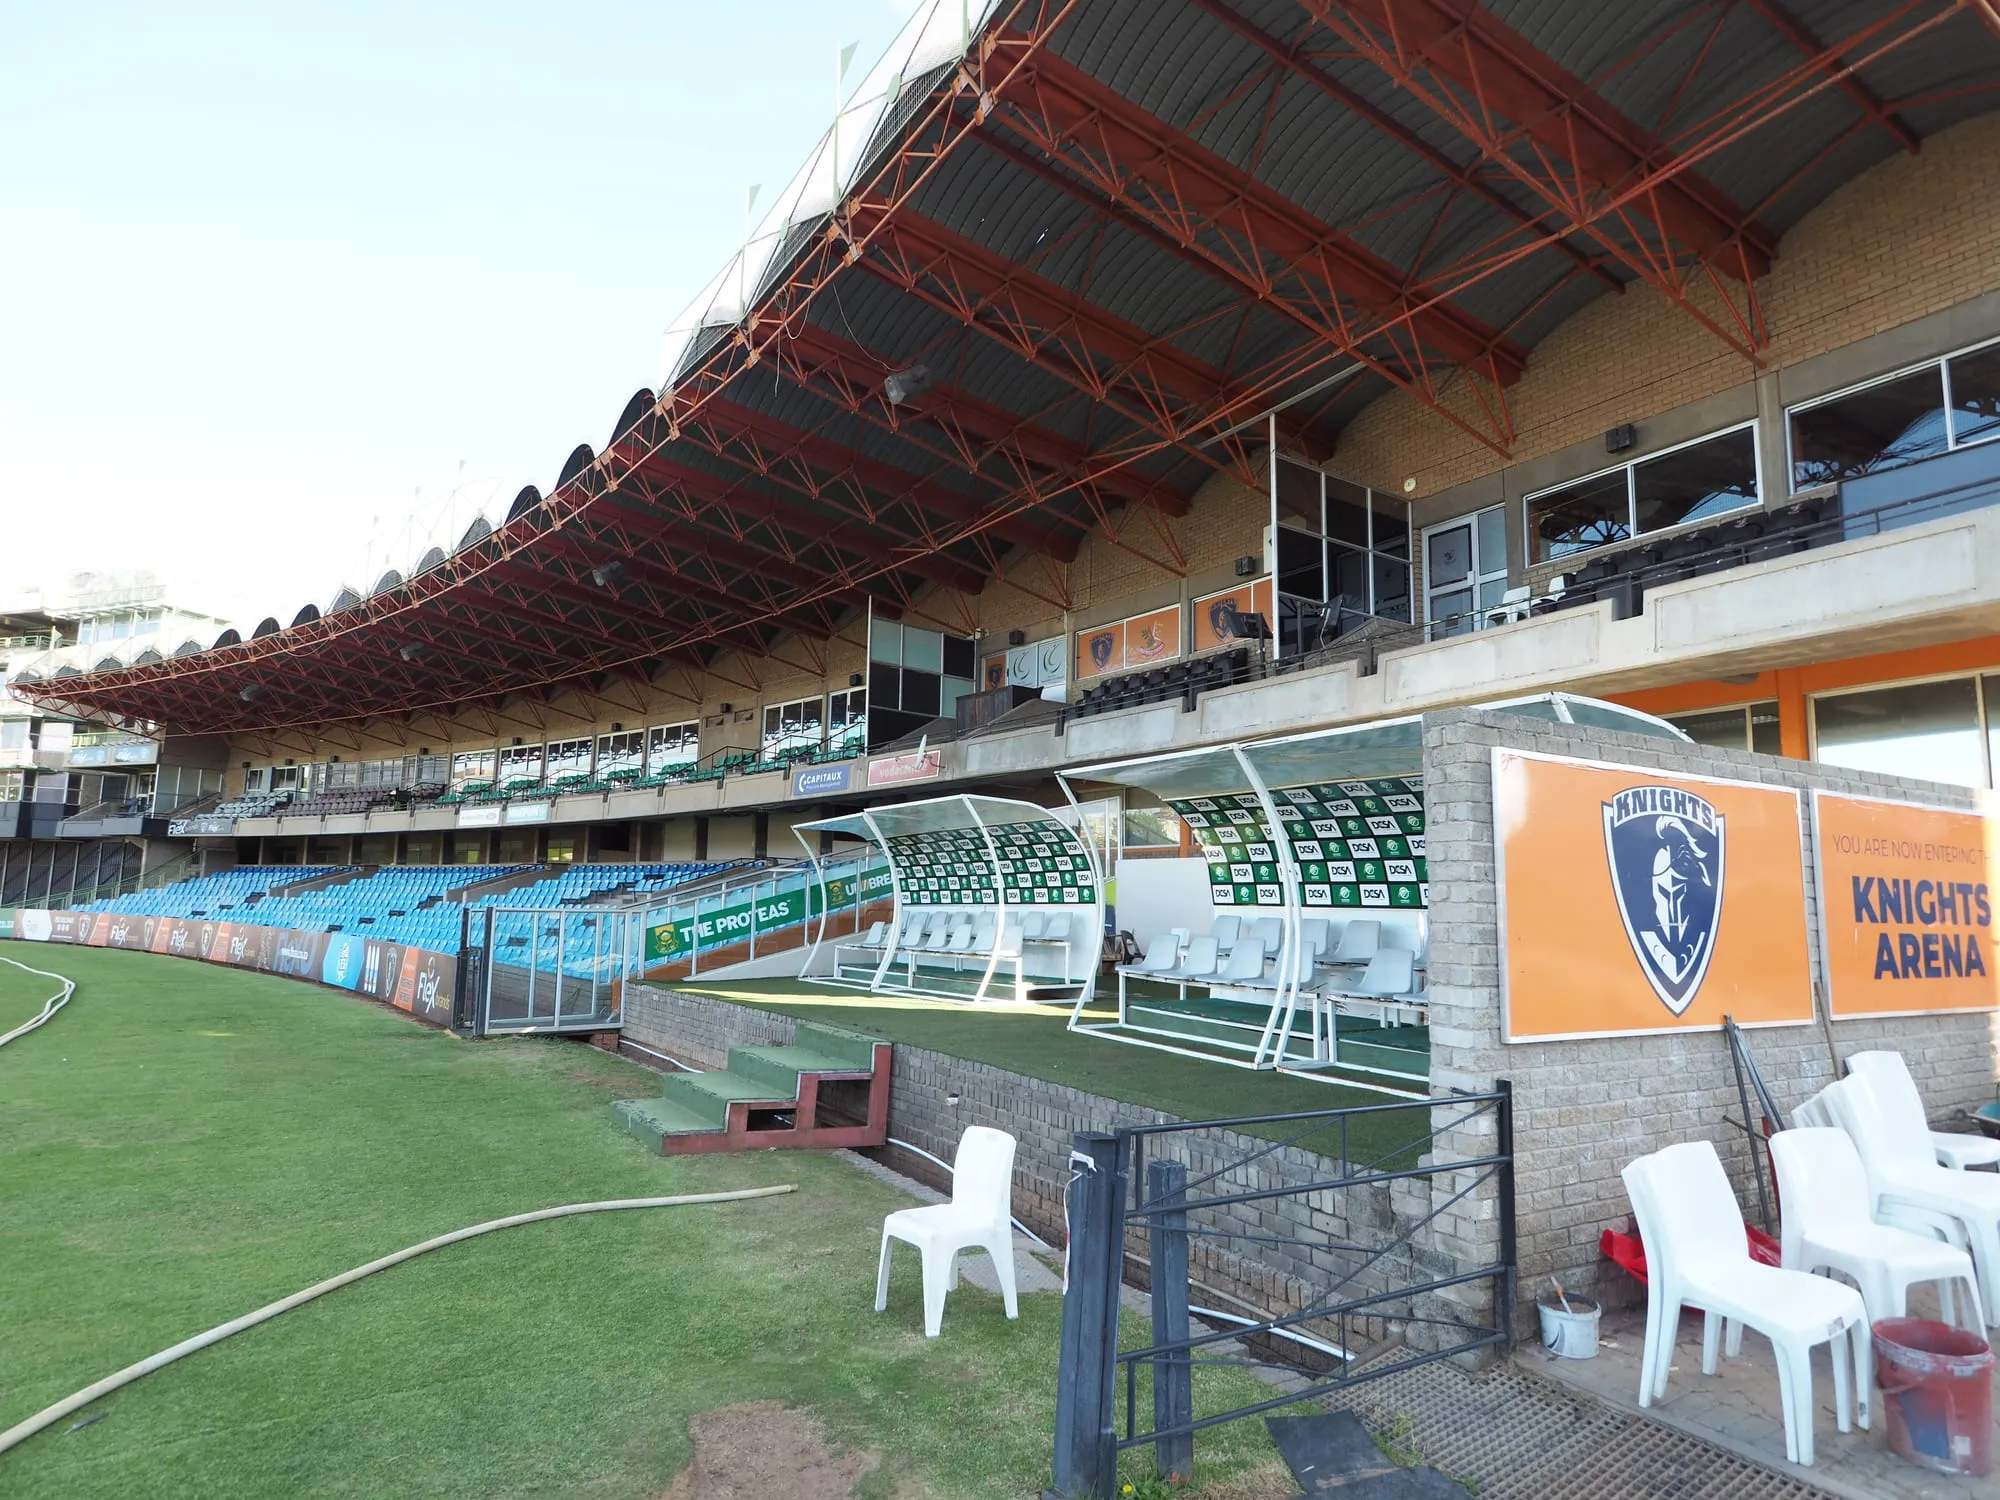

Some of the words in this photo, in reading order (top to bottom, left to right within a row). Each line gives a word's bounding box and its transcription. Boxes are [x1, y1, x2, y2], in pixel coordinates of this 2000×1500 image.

[806, 772, 842, 784] CAPITAUX
[1615, 788, 1713, 830] KNIGHTS
[1833, 834, 1860, 854] YOU
[1864, 838, 1889, 857] ARE
[1892, 841, 1922, 859] NOW
[1925, 844, 1976, 864] ENTERING
[1852, 876, 1991, 927] KNIGHTS
[1874, 932, 1986, 980] ARENA
[417, 972, 440, 1014] Flex
